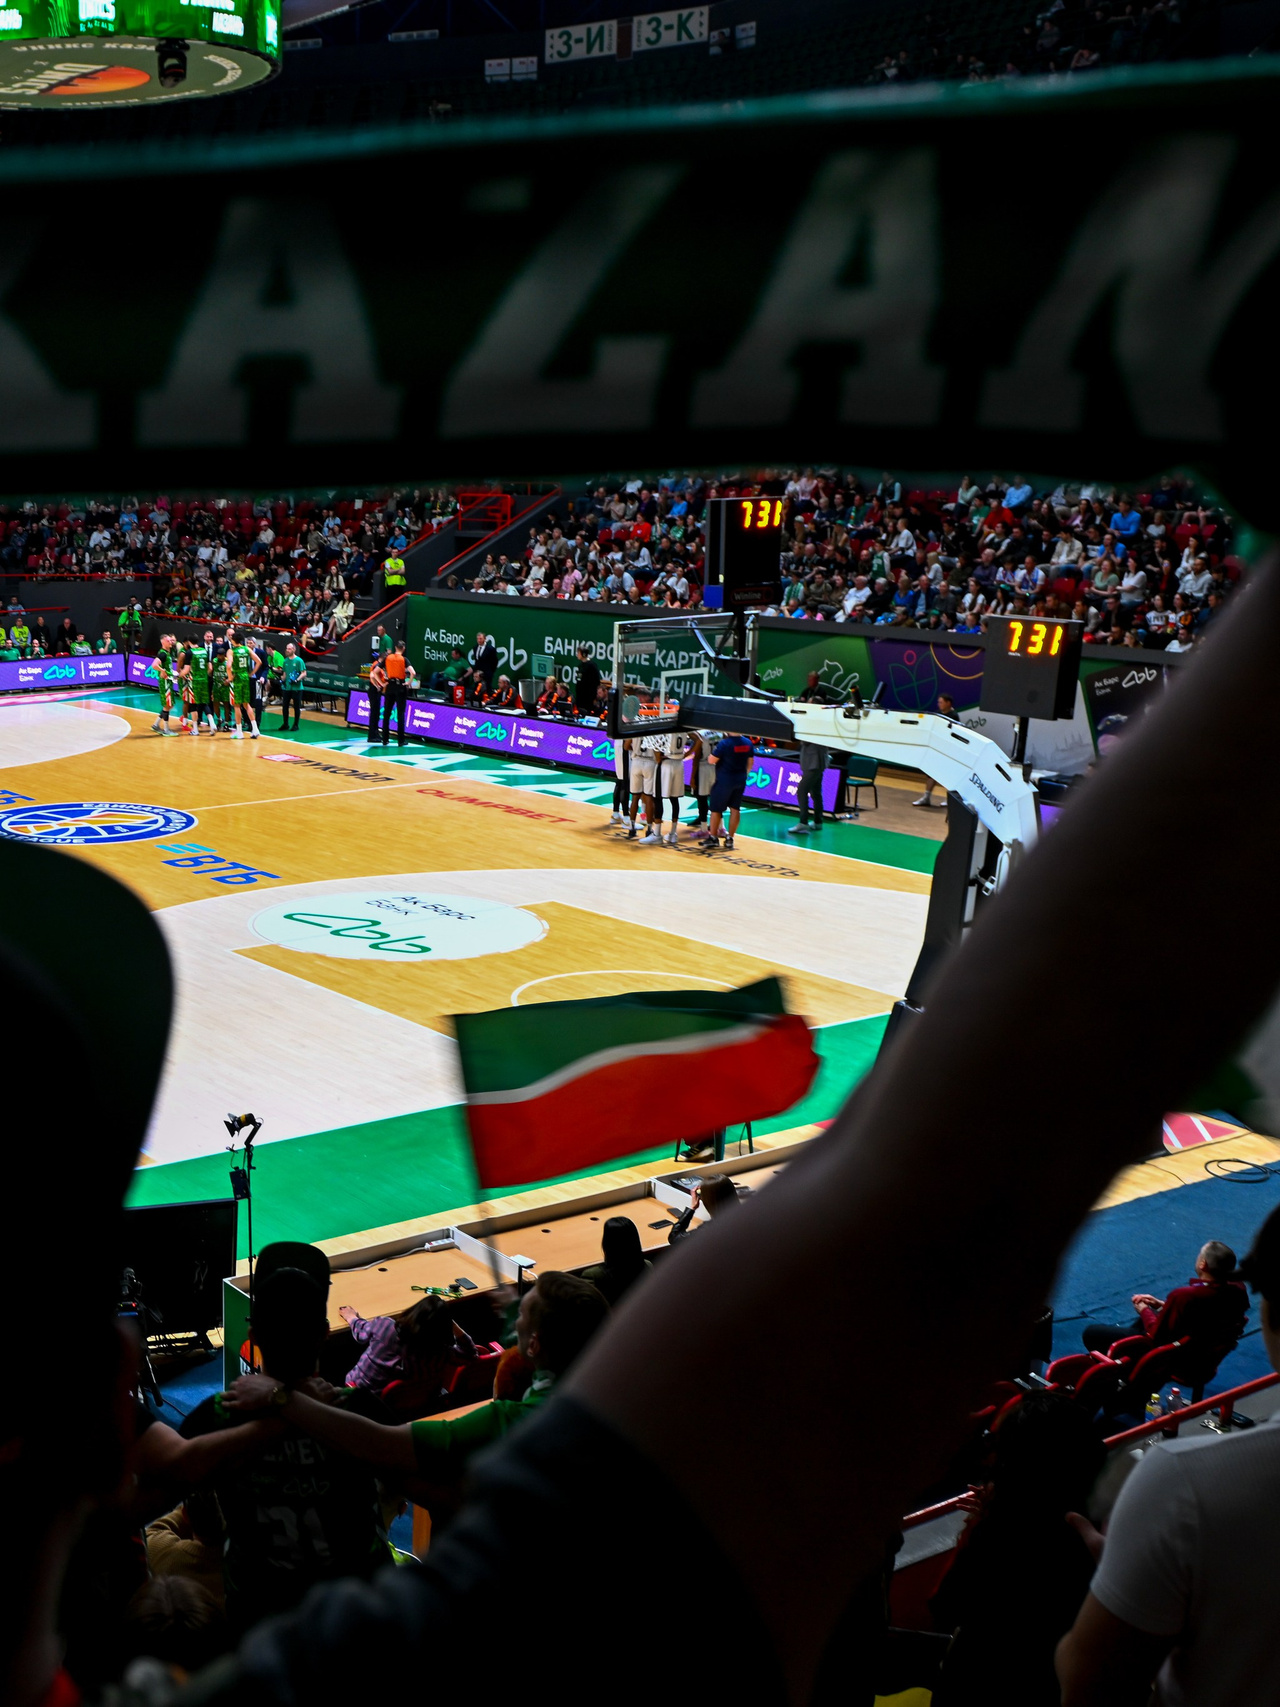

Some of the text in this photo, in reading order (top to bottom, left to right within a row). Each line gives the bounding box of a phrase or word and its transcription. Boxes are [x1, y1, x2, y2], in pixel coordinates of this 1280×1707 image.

[556, 25, 605, 58] 3-И
[645, 11, 695, 46] 3-К
[742, 501, 782, 528] 731
[424, 628, 465, 647] Ак Барс
[1010, 621, 1063, 656] 731
[199, 658, 206, 669] 2
[424, 646, 448, 662] Банк
[456, 689, 462, 698] 5
[677, 736, 682, 750] 0
[416, 788, 576, 824] OLIMPBET
[969, 773, 1005, 813] SPALDING
[162, 854, 282, 885] ВТБ
[256, 1505, 334, 1570] 31
